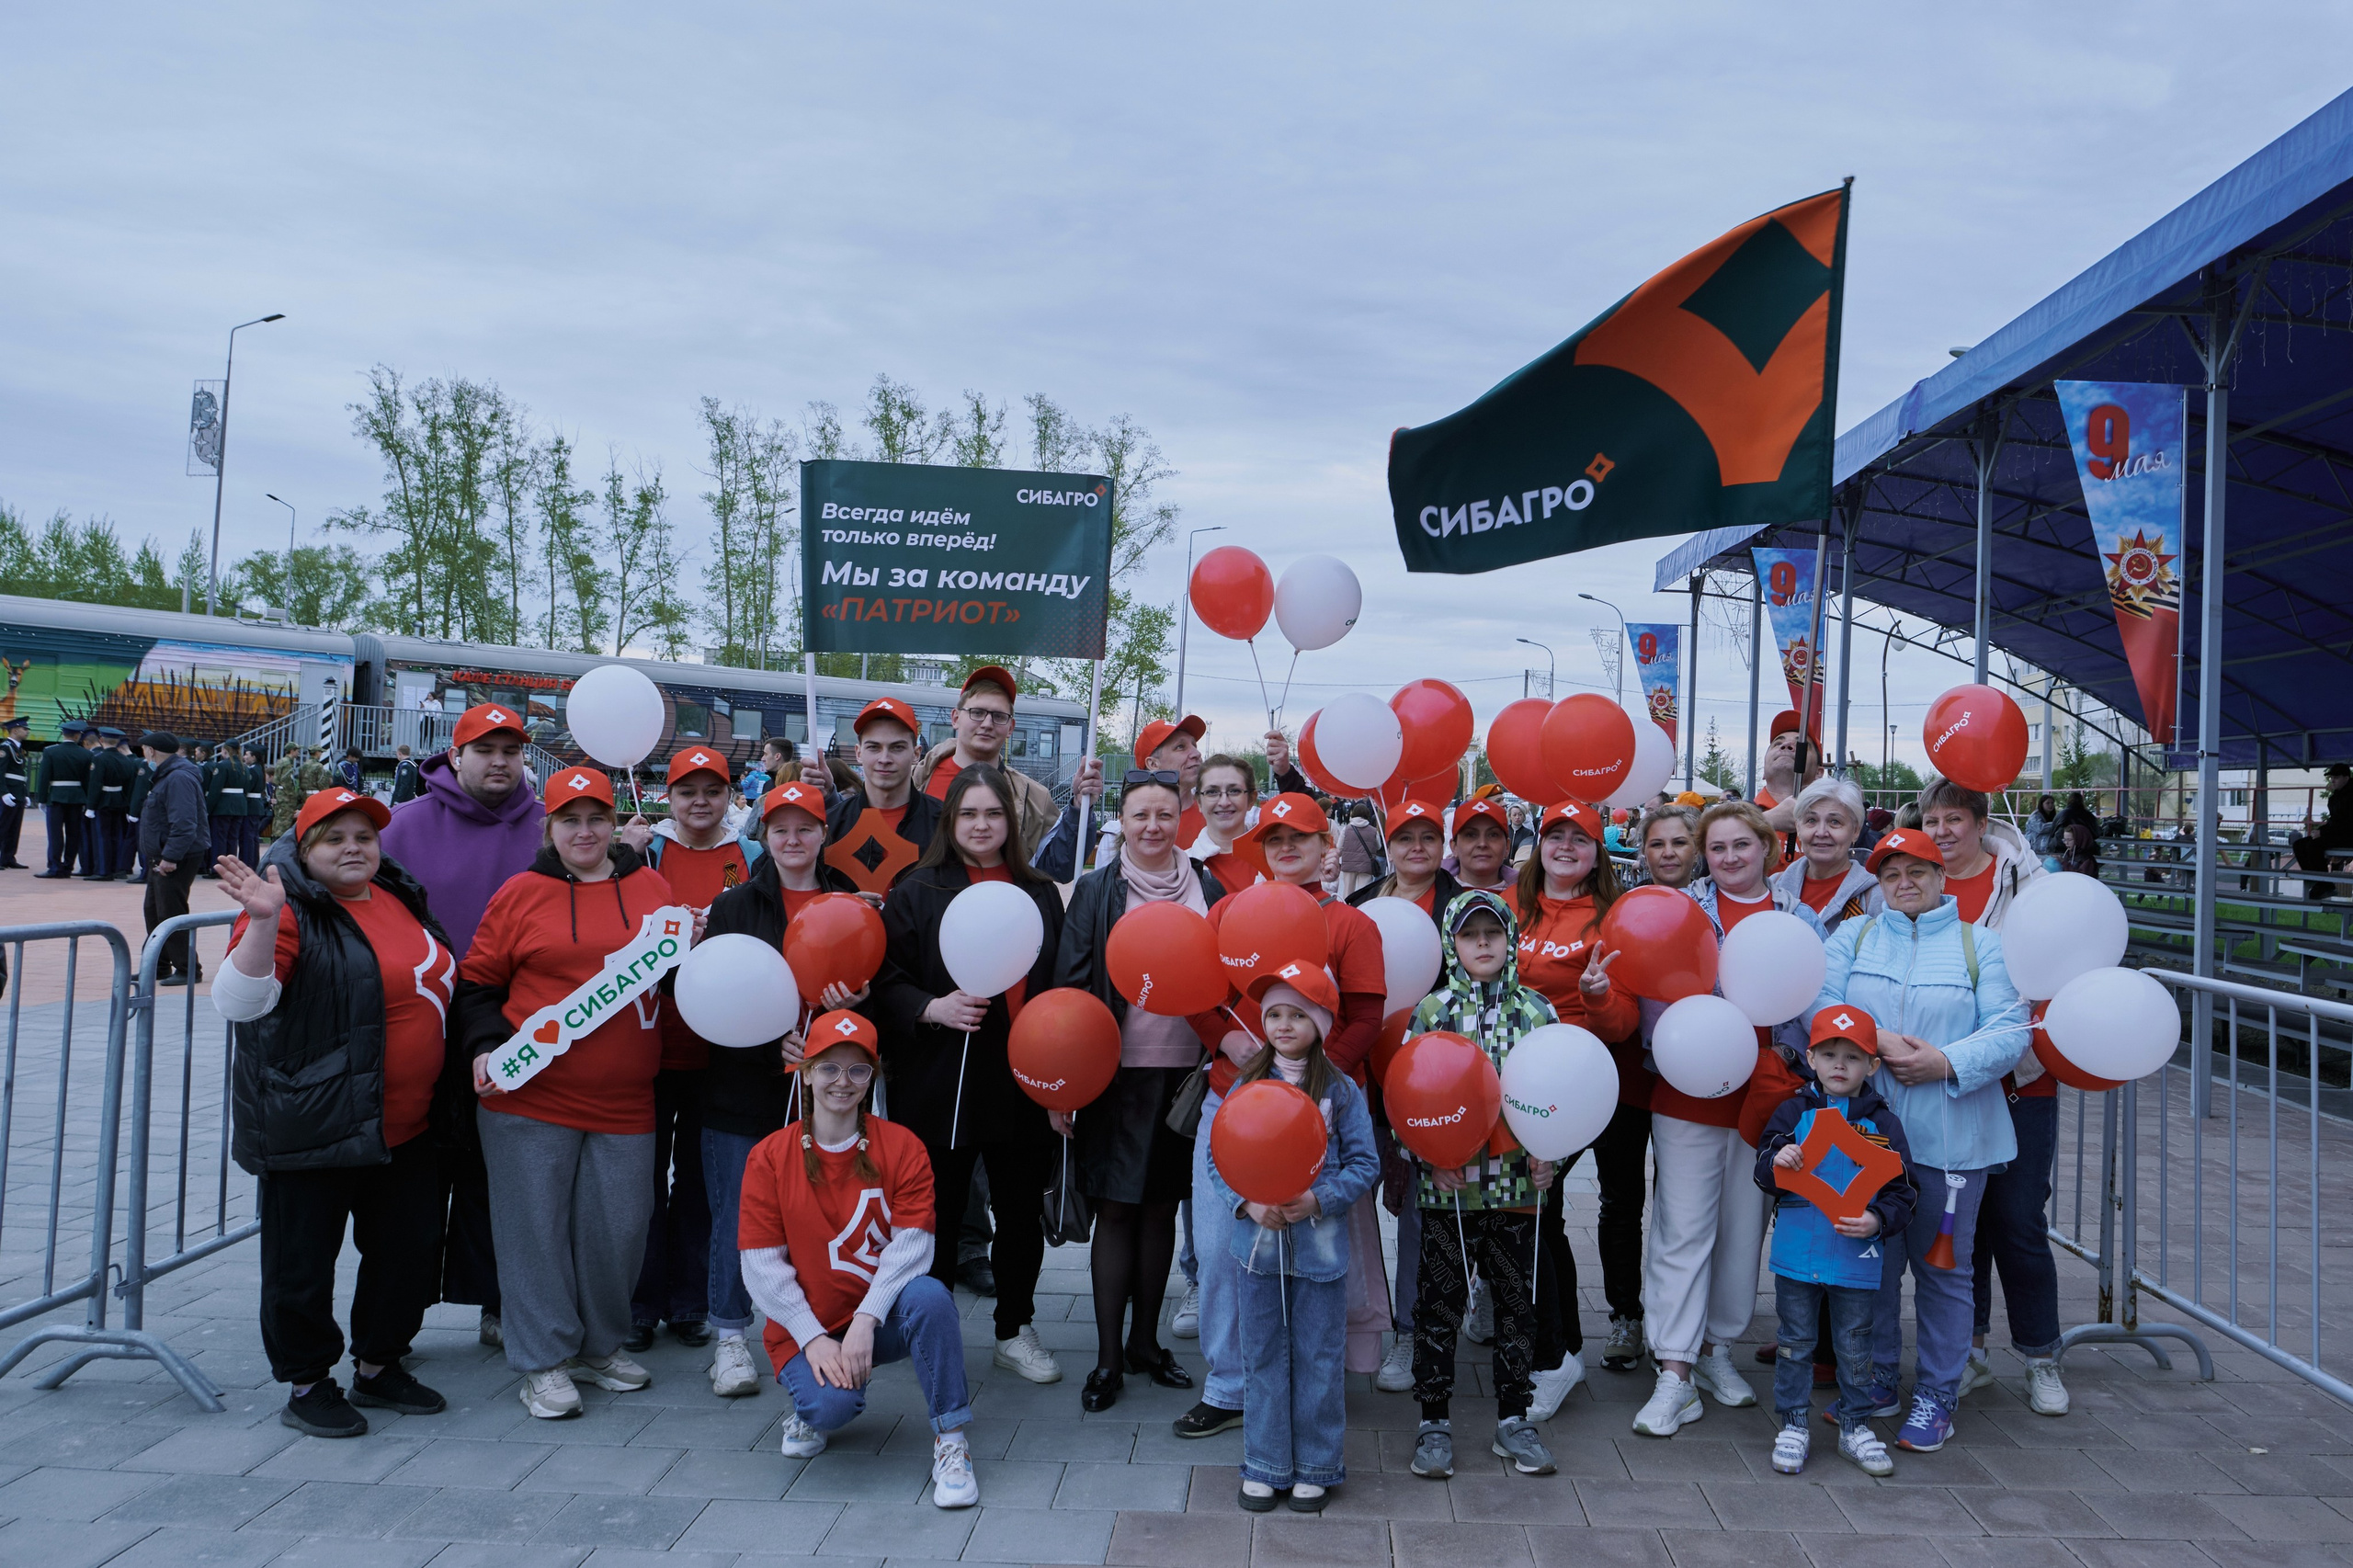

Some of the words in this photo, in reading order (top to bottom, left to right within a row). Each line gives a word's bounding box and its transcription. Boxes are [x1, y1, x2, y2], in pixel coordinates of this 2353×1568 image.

[2089, 405, 2130, 481] 9
[2104, 451, 2172, 483] мая
[1017, 488, 1098, 507] СИБАГРО
[1419, 479, 1595, 539] СИБАГРО
[821, 502, 904, 524] Всегда
[910, 507, 971, 526] идём
[821, 528, 900, 546] только
[905, 531, 997, 551] вперёд!
[821, 560, 880, 586] Мы
[887, 567, 928, 588] за
[937, 569, 1091, 599] команду
[1770, 562, 1796, 607] 9
[821, 597, 1020, 624] «ПАТРИОТ»
[1639, 632, 1657, 665] 9
[452, 670, 493, 685] КАФЕ
[494, 674, 558, 689] СТАНЦИЯ
[1933, 718, 1969, 753] СИБАГРО
[1573, 765, 1618, 777] СИБАГРО
[501, 1043, 540, 1079] #Я
[564, 938, 678, 1028] СИБАГРО
[1013, 1068, 1059, 1091] СИБАГРО
[1504, 1094, 1550, 1119] СИБАГРО
[1406, 1113, 1461, 1128] СИБАГРО
